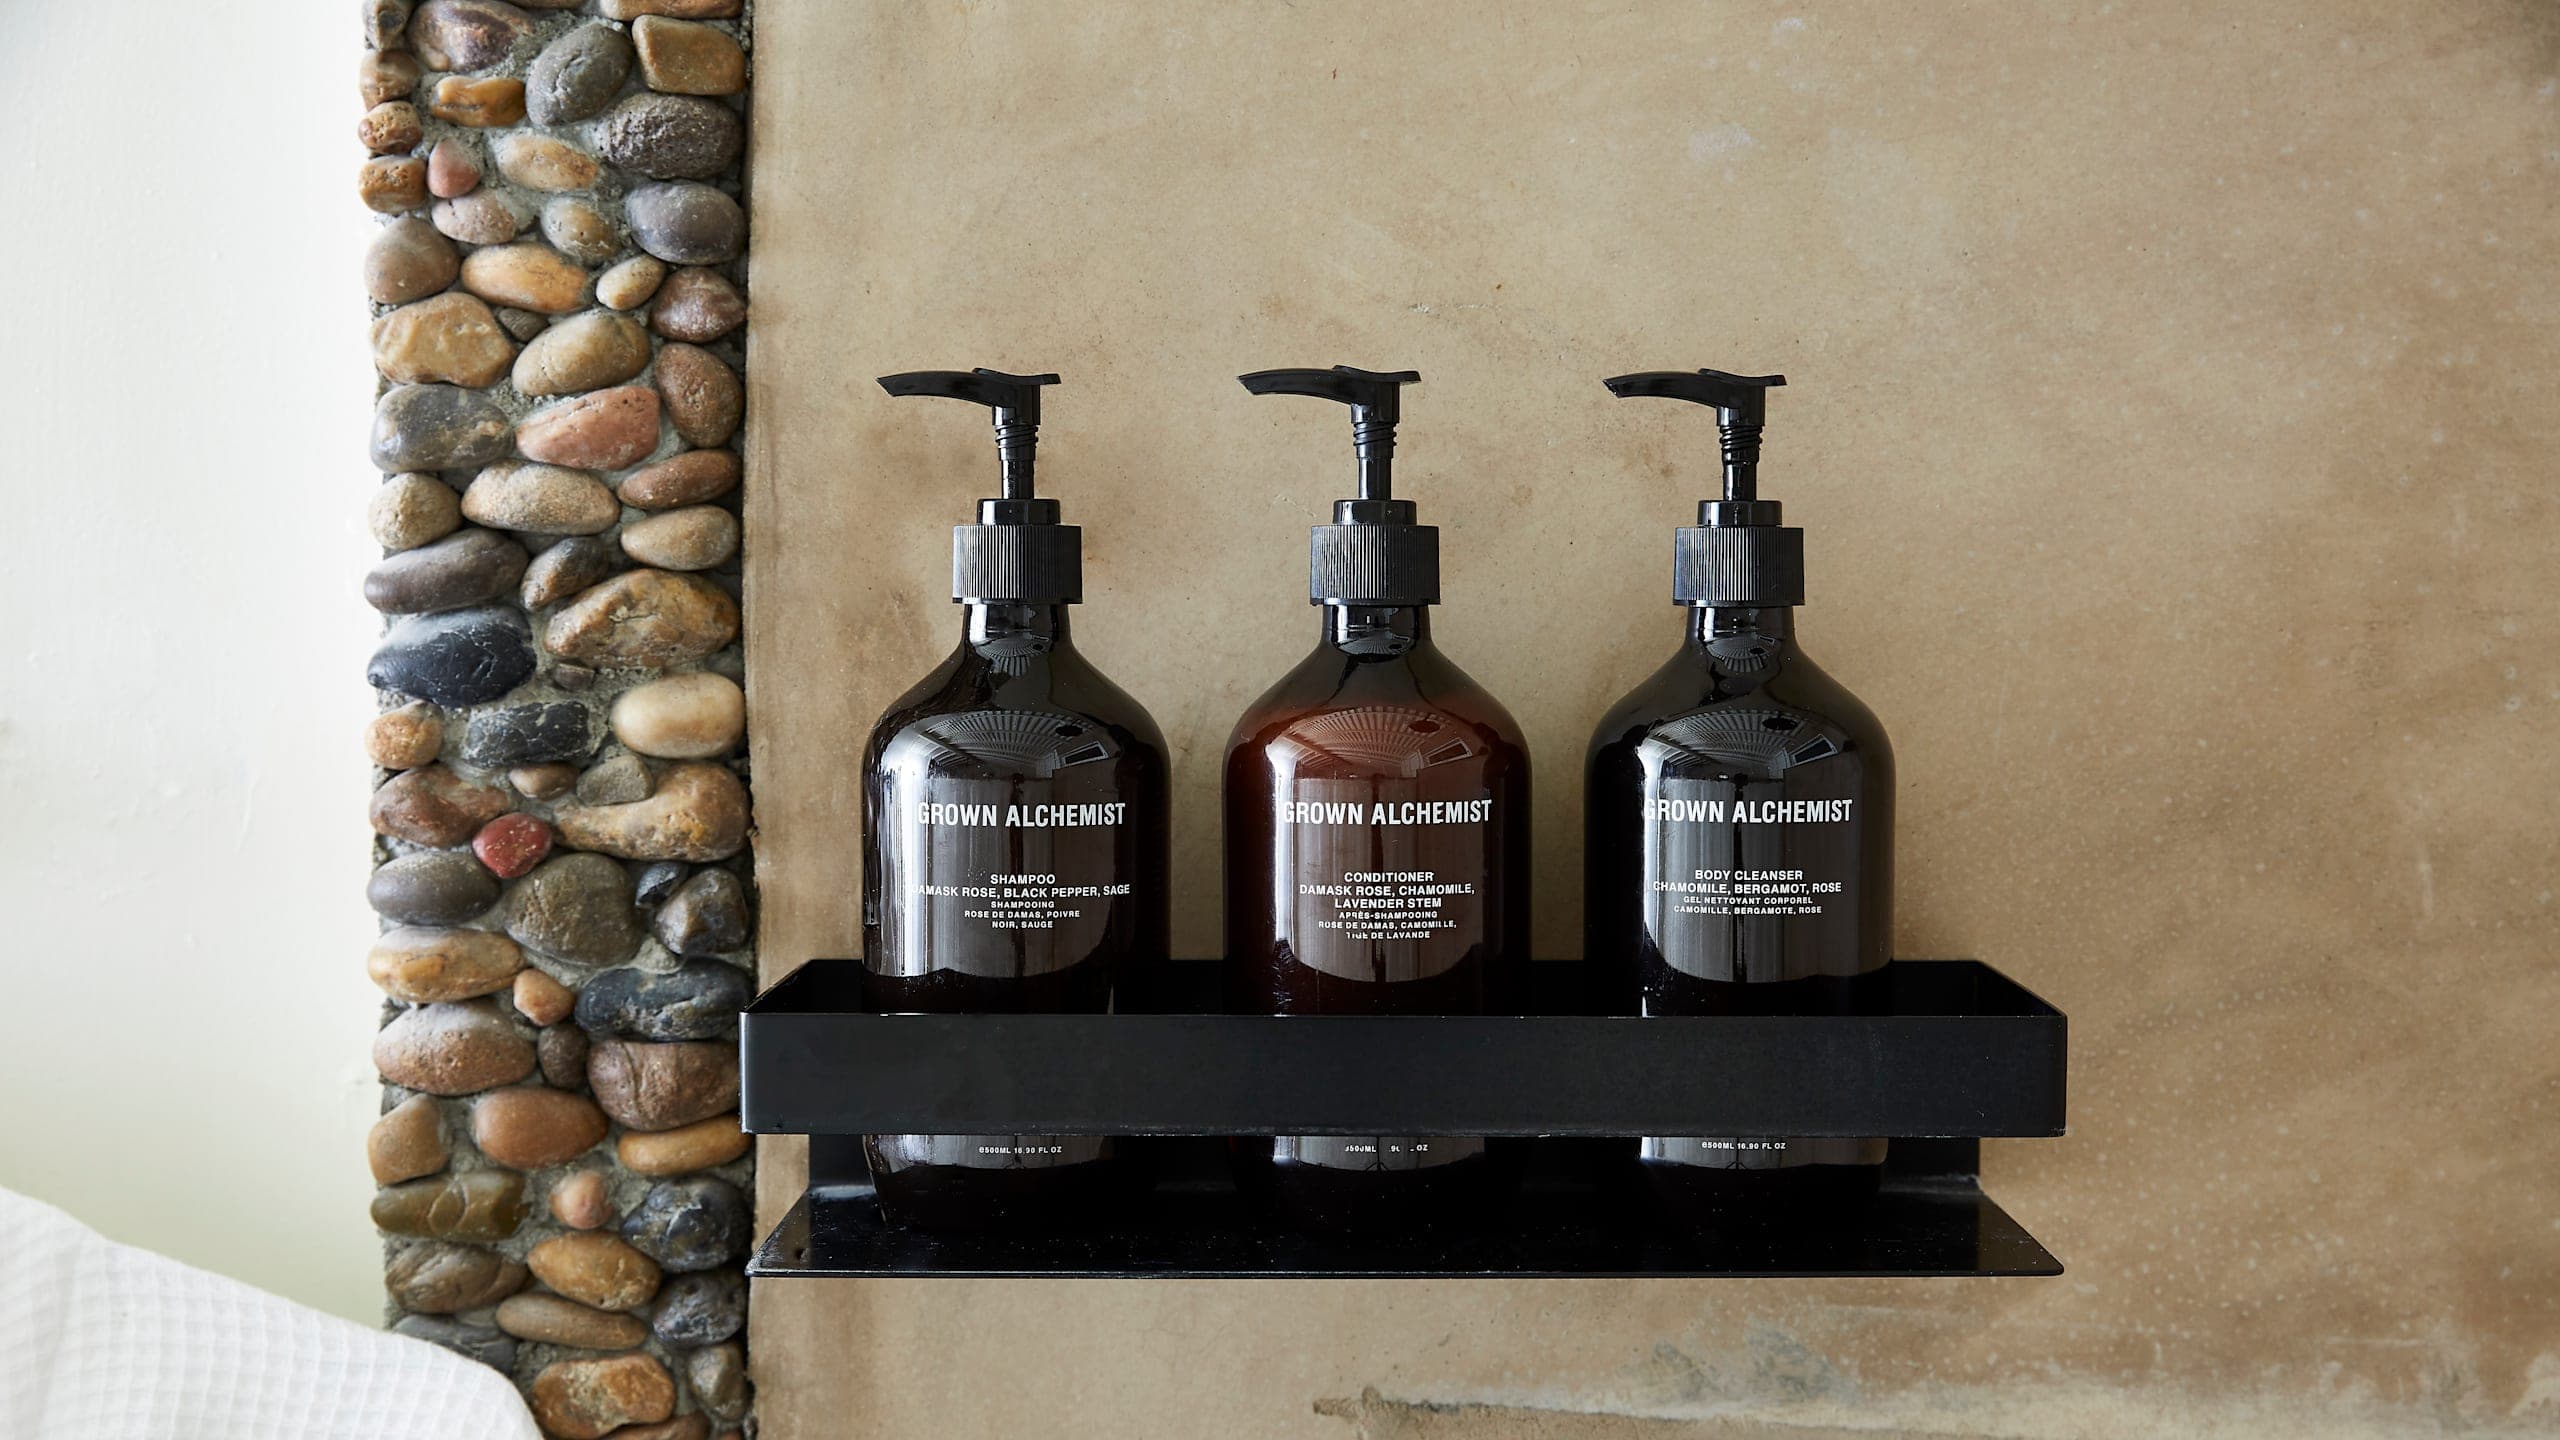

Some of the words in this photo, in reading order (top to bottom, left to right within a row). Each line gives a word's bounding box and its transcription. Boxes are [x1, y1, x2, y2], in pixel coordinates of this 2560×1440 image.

[918, 802, 997, 827] GROWN
[1005, 803, 1126, 827] ALCHEMIST
[1283, 801, 1363, 825] GROWN
[1371, 799, 1492, 825] ALCHEMIST
[1643, 799, 1724, 823] GROWN
[1732, 799, 1853, 823] ALCHEMIST
[990, 874, 1056, 885] SHAMPOO
[1344, 872, 1434, 882] CONDITIONER
[1695, 869, 1731, 880] BODY
[1734, 870, 1803, 881] CLEANSER
[962, 886, 1000, 899] ROSE,
[1003, 887, 1048, 898] BLACK
[1051, 886, 1101, 898] PEPPER,
[1103, 884, 1130, 896] SAGE
[1300, 884, 1352, 896] DAMASK
[1355, 885, 1395, 898] ROSE,
[1399, 884, 1475, 896] CHAMOMILE,
[1653, 881, 1731, 895] CHAMOMILE,
[1734, 883, 1810, 895] BERGAMOT,
[1812, 882, 1842, 893] ROSE
[991, 901, 1055, 909] SHAMPOOING
[1334, 898, 1404, 909] LAVENDER
[1407, 898, 1442, 908] STEM
[1683, 895, 1701, 904] GEL
[1704, 896, 1761, 905] NETTOYANT
[1764, 896, 1813, 904] CORPOREL
[964, 910, 989, 918] ROSE
[1008, 911, 1044, 919] DAMAS,
[1047, 910, 1080, 918] POIVRE
[1338, 910, 1438, 919] APRÈS-SHAMPOOING
[1673, 905, 1731, 915] CAMOMILLE,
[1734, 906, 1796, 915] BERGAMOTE,
[1799, 906, 1822, 914] ROSE
[992, 921, 1019, 930] NOIR,
[1021, 921, 1053, 929] SAUGE
[1318, 921, 1343, 929] ROSE
[1361, 922, 1398, 930] DAMAS,
[1387, 931, 1430, 939] LAVANDE
[1039, 1146, 1048, 1154] FL
[1050, 1146, 1062, 1154] OZ
[1416, 1144, 1429, 1152] OZ
[1761, 1142, 1773, 1150] FL
[1774, 1142, 1786, 1150] OZ
